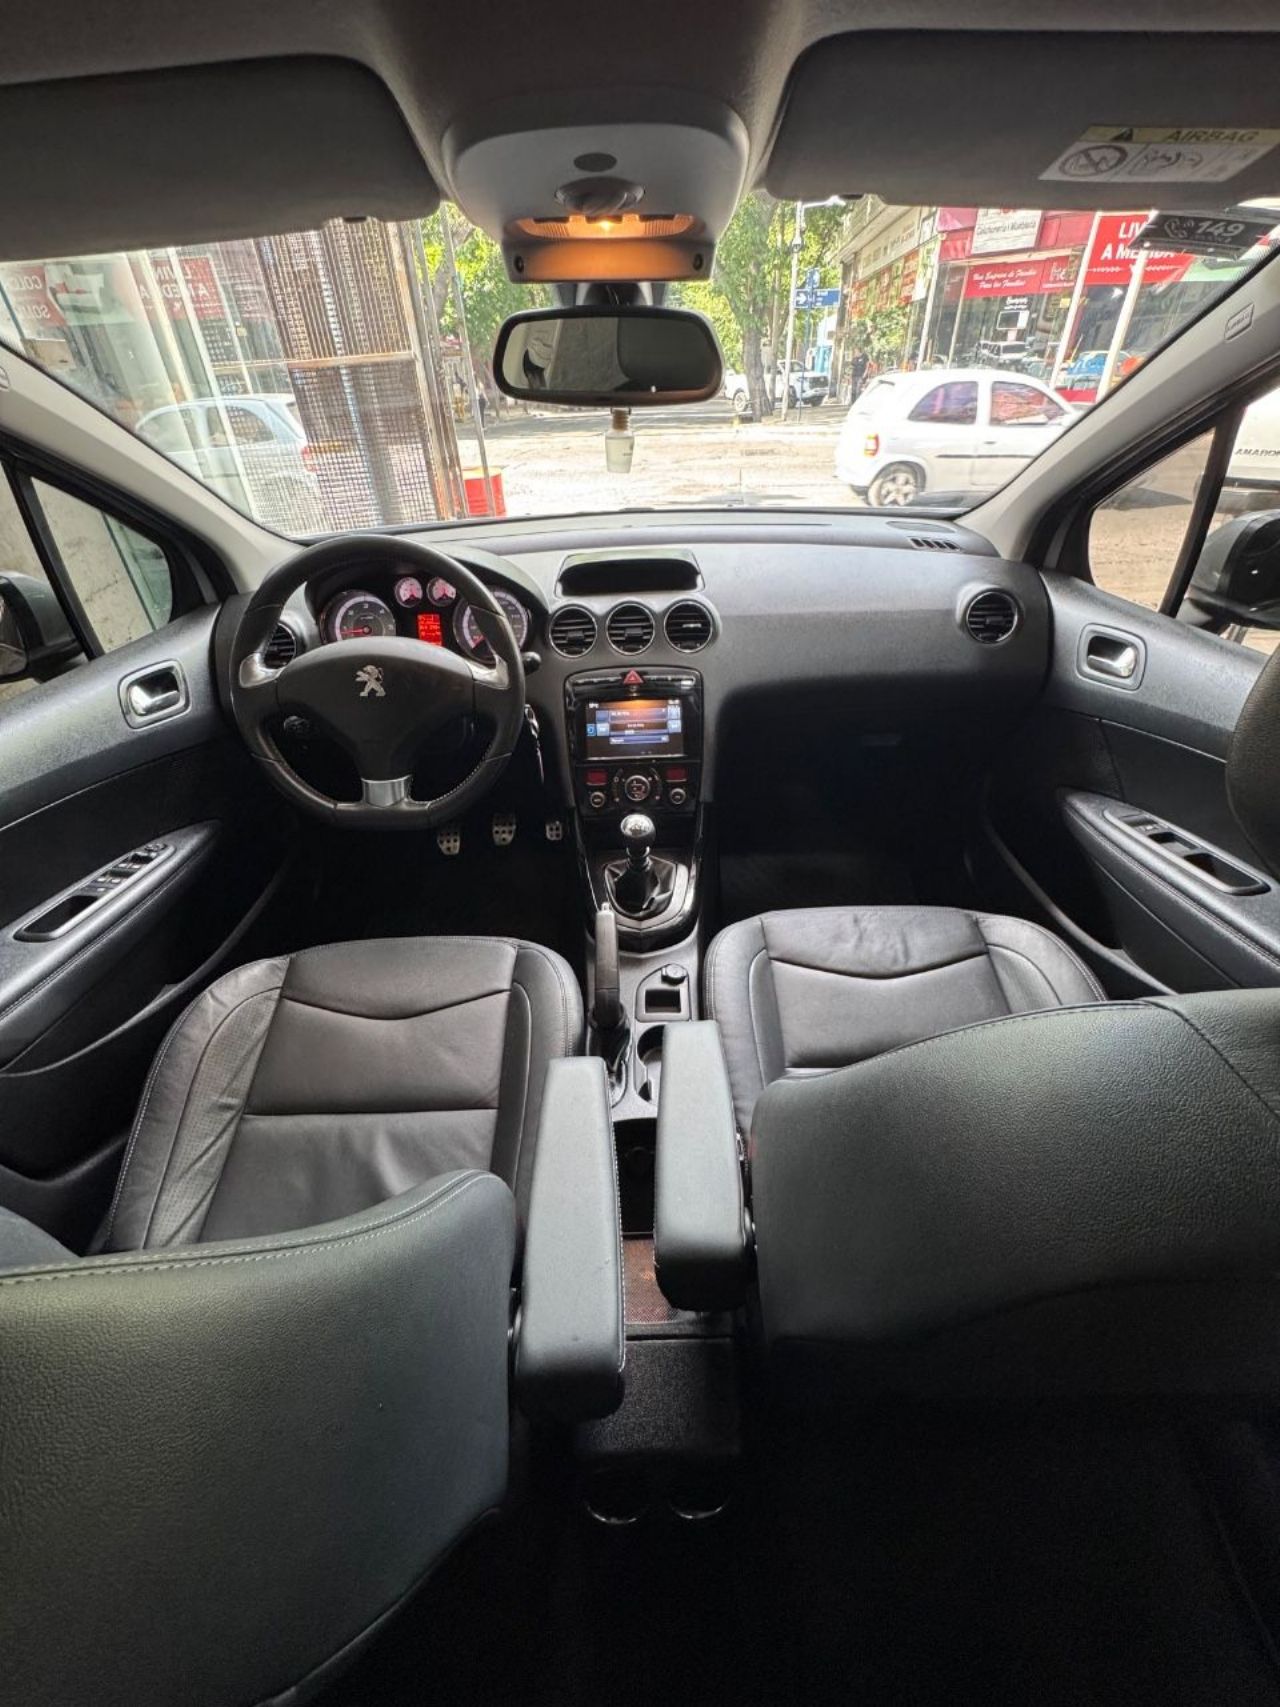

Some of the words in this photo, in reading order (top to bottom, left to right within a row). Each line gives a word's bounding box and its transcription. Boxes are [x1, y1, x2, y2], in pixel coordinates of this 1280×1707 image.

[1163, 129, 1260, 143] AIRBAG
[1196, 220, 1246, 237] 149
[1101, 243, 1113, 260] A
